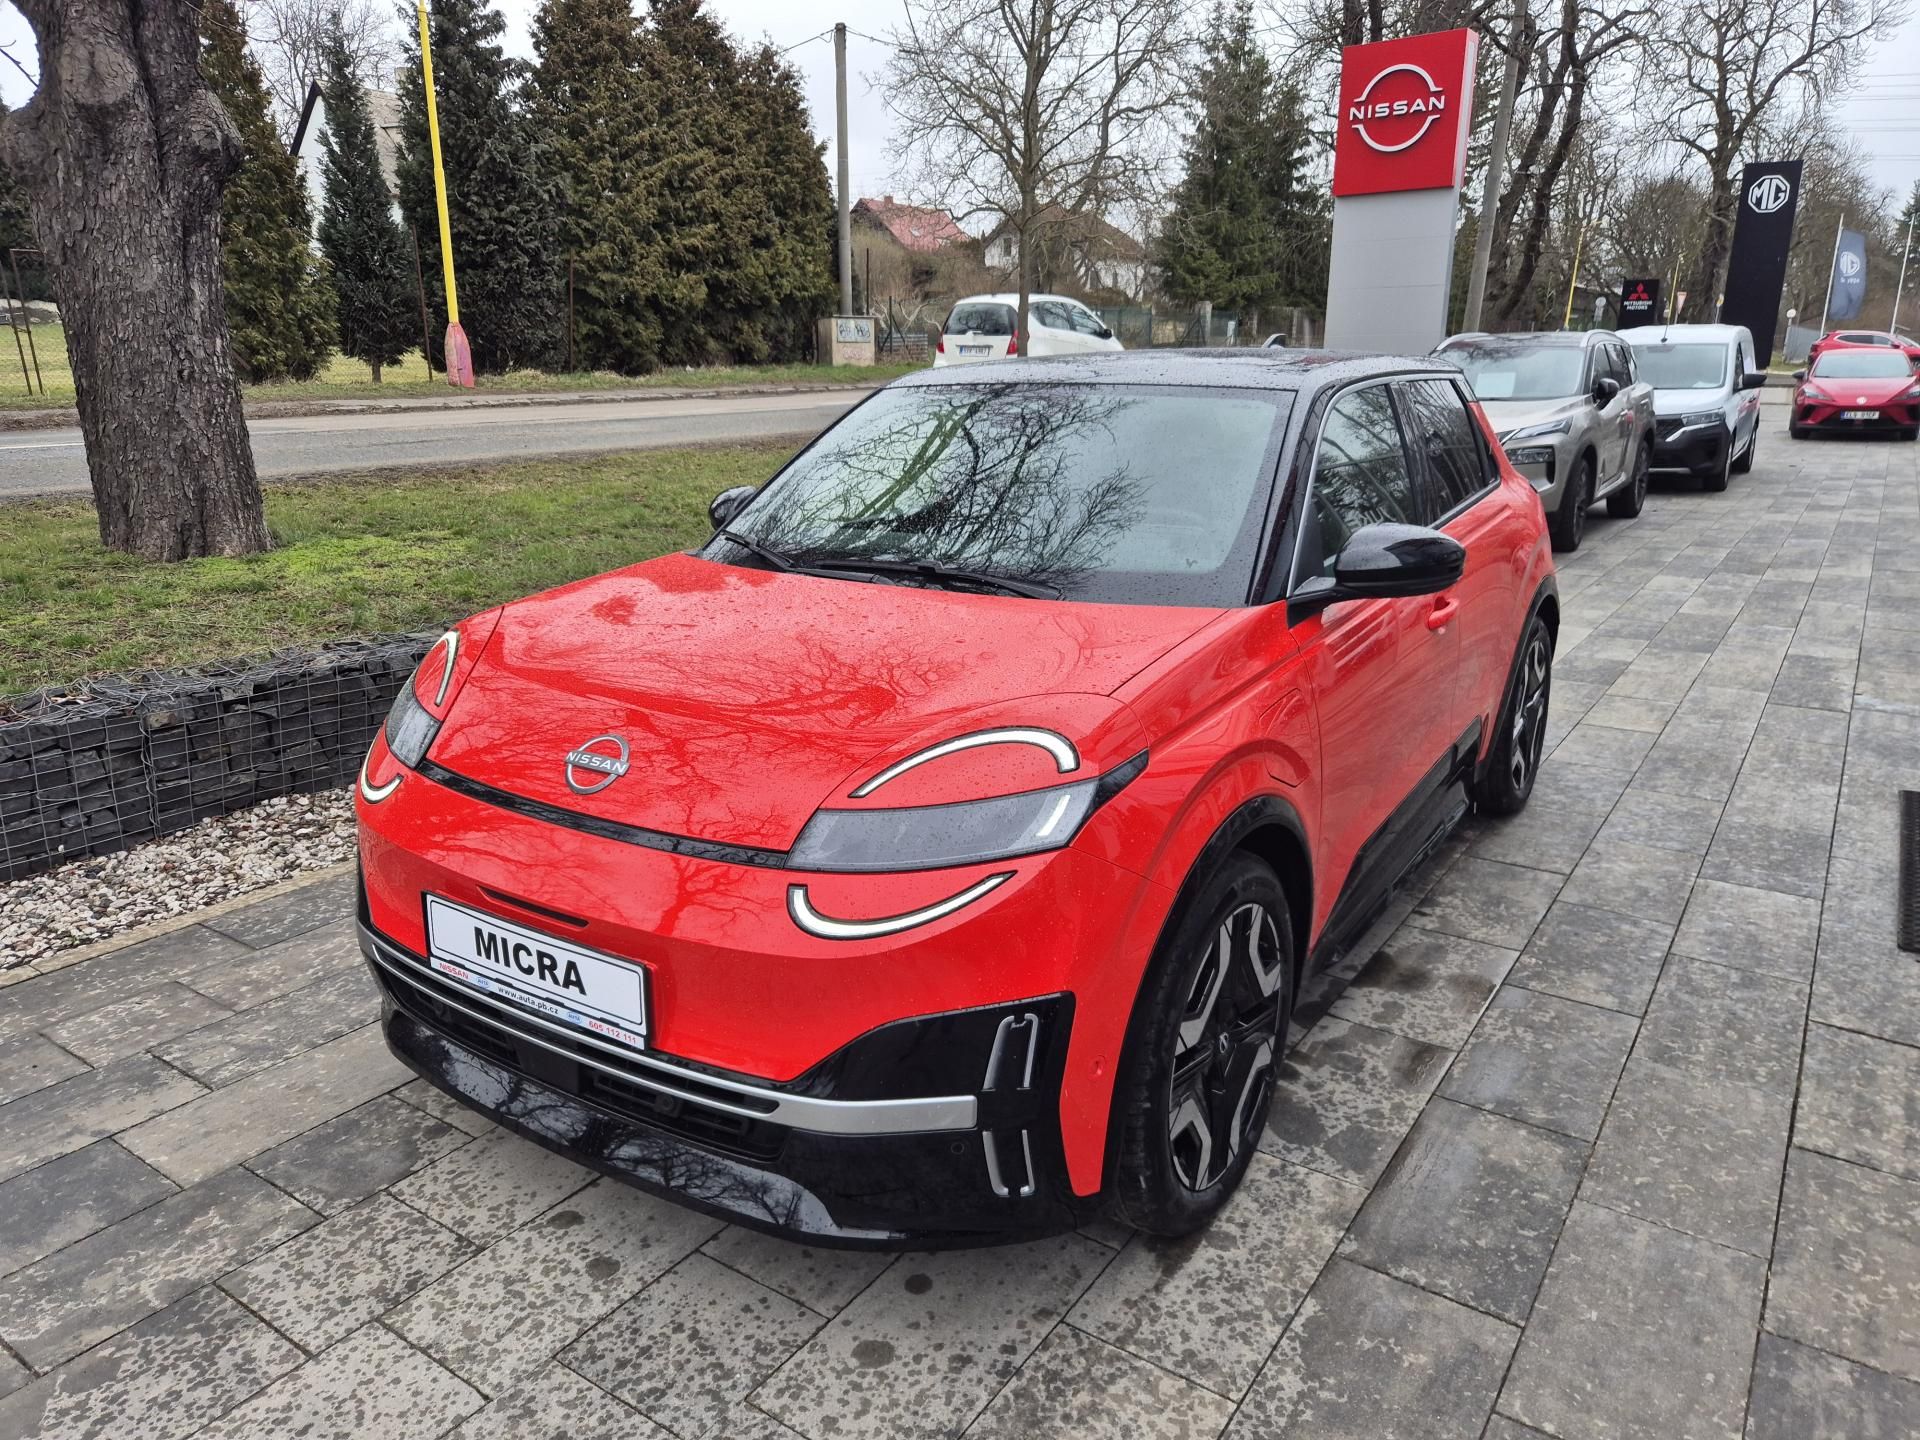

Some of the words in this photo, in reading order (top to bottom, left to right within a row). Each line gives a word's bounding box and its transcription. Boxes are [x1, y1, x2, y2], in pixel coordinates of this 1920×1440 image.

[1349, 95, 1445, 121] NISSAN
[1751, 178, 1787, 210] MG
[565, 751, 627, 774] NISSAN
[474, 926, 587, 996] MICRA
[439, 962, 469, 980] NISSAN
[498, 986, 559, 1015] www.auta.pb.cz
[588, 1020, 604, 1032] 605
[606, 1026, 621, 1039] 112
[623, 1033, 637, 1045] 111
